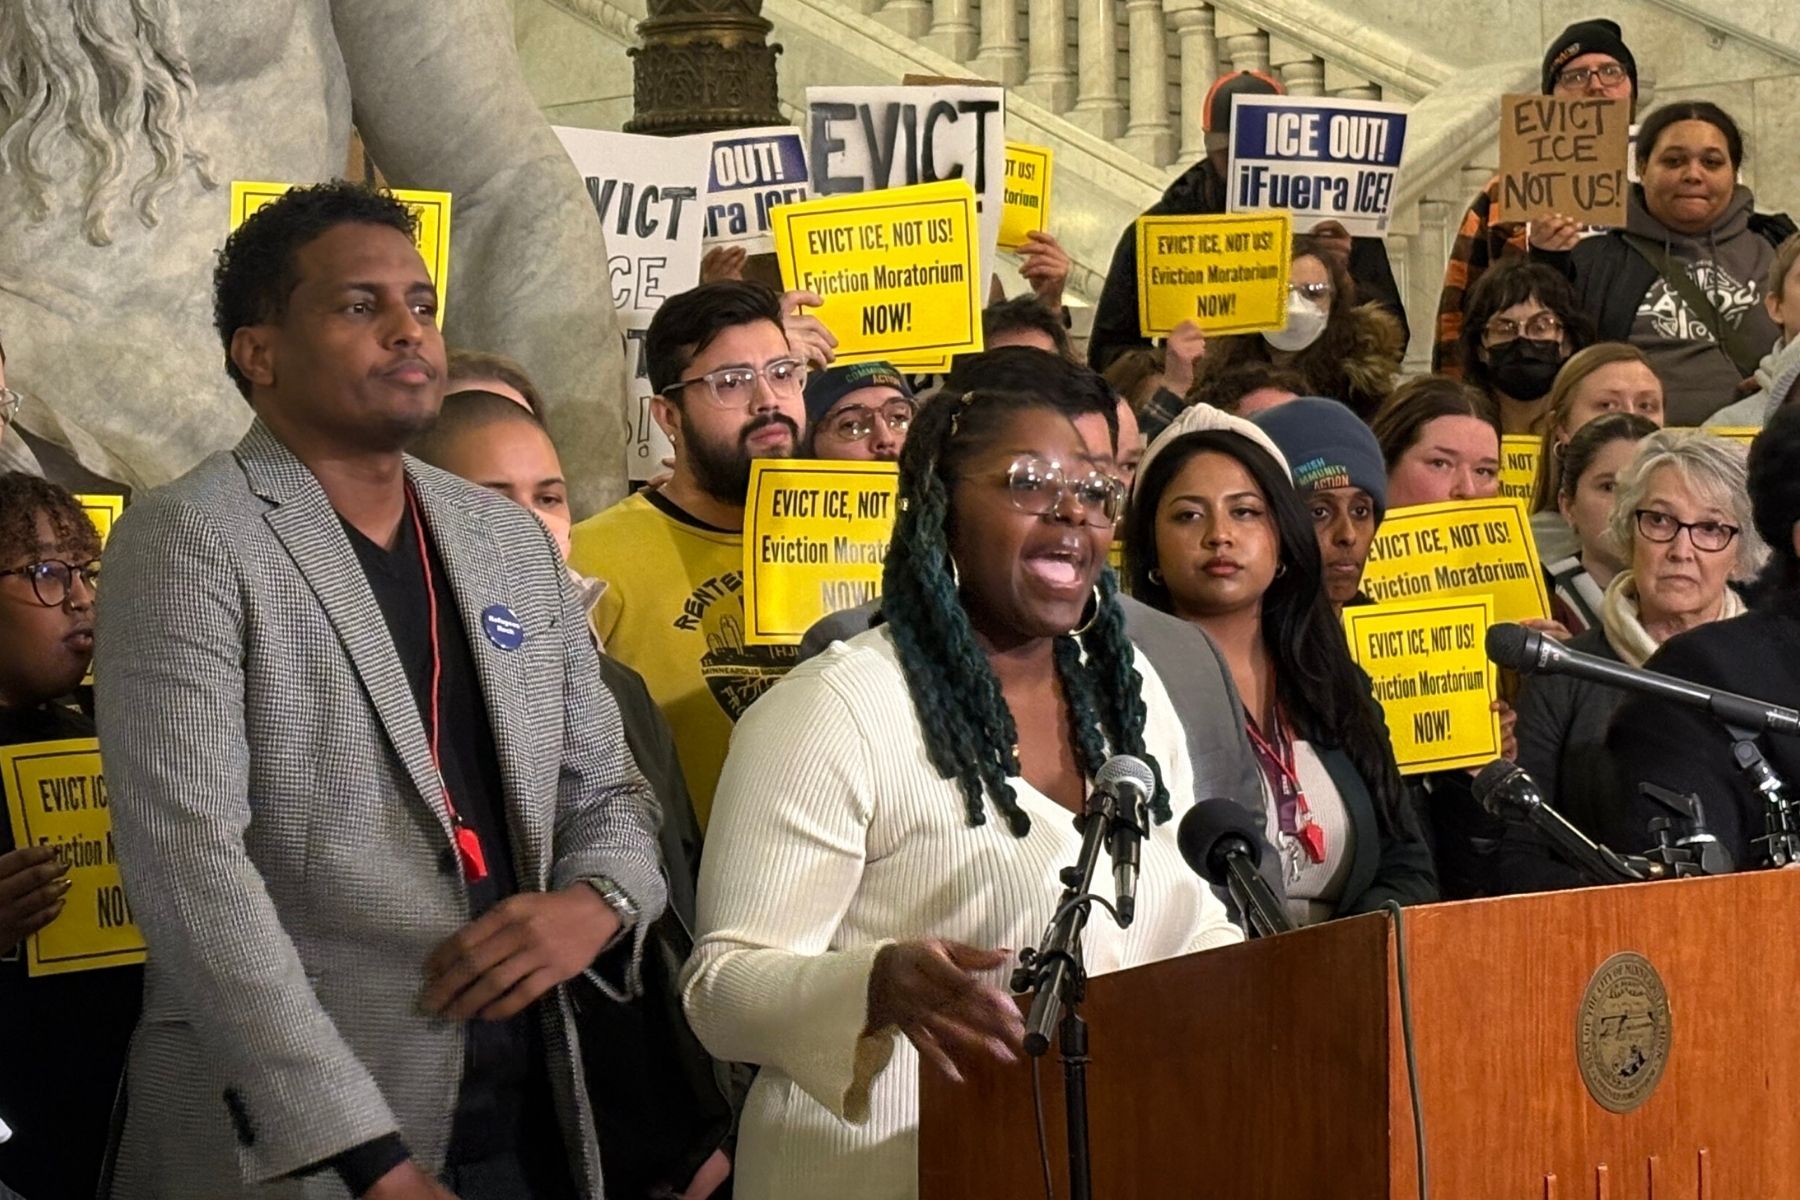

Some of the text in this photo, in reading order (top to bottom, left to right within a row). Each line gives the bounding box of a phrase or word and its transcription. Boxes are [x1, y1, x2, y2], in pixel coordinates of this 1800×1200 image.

[1514, 100, 1615, 136] EVICT
[810, 100, 999, 196] EVICT
[1265, 112, 1390, 163] ICE OUT!
[1528, 135, 1598, 165] ICE
[714, 142, 785, 187] OUT!
[1018, 161, 1035, 181] US!
[1004, 187, 1039, 209] torium
[1353, 170, 1394, 214] ICE!
[1505, 169, 1622, 211] NOT US!
[585, 177, 697, 241] VICT
[808, 217, 954, 256] EVICT ICE, NOT US!
[1157, 234, 1196, 255] EVICT
[1224, 233, 1251, 252] NOT
[1252, 231, 1274, 250] US!
[607, 255, 667, 309] CE
[804, 260, 963, 296] Eviction Moratorium
[1152, 261, 1279, 285] Eviction Moratorium
[862, 302, 913, 336] NOW!
[1196, 294, 1237, 317] NOW!
[1507, 453, 1533, 471] NOT
[1314, 475, 1350, 491] ACTION
[773, 489, 891, 523] EVICT ICE, NOT
[762, 535, 891, 564] Eviction Morat
[1415, 528, 1448, 556] ICE,
[1449, 523, 1481, 549] NOT
[1486, 521, 1512, 545] US!
[1363, 558, 1529, 601] Eviction Moratorium
[673, 570, 742, 631] RENTE
[1368, 623, 1475, 660] EVICT ICE, NOT US!
[1418, 666, 1484, 697] Moratorium
[1413, 709, 1452, 744] NOW!
[38, 774, 107, 813] EVICT IC
[38, 834, 103, 869] iction
[97, 885, 134, 929] NO
